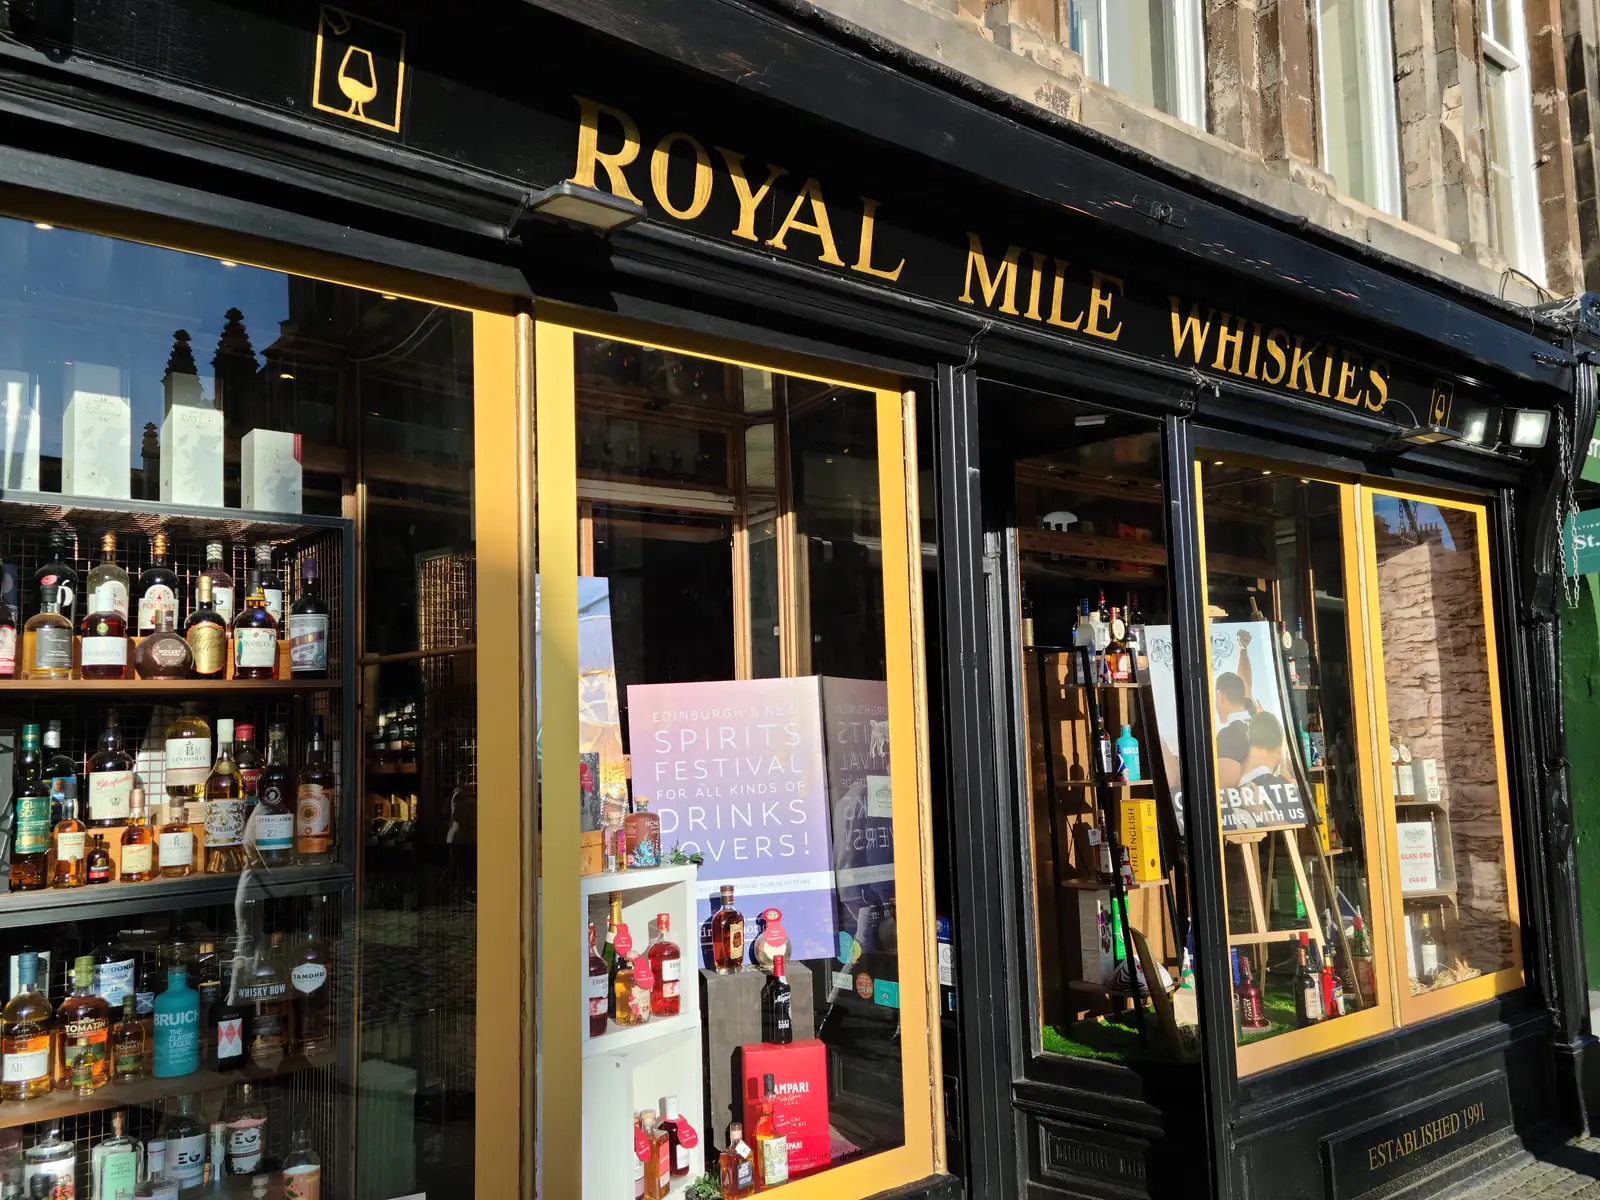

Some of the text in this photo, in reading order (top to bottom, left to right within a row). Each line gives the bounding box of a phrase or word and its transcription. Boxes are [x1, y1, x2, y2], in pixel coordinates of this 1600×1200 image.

[566, 94, 1391, 412] ROYAL MILE WHISKIES
[1574, 535, 1600, 549] St.
[652, 706, 758, 723] EDINBURGH'S
[654, 722, 801, 754] SPIRITS
[655, 754, 803, 782] FESTIVAL
[656, 781, 805, 801] FOR ALL KINDS OF
[1174, 782, 1301, 811] CEBRATE
[657, 799, 807, 834] DRINKS
[1252, 810, 1285, 823] WITH
[1288, 808, 1305, 820] US
[1128, 808, 1137, 851] ENGLISH
[293, 972, 325, 980] TAMDHU
[238, 984, 286, 998] WHISKY ROW
[65, 1020, 106, 1033] TOMATIN
[169, 1028, 183, 1037] THE
[774, 1081, 809, 1095] AMPARI
[1367, 1101, 1486, 1171] ESTABLISHED 1991
